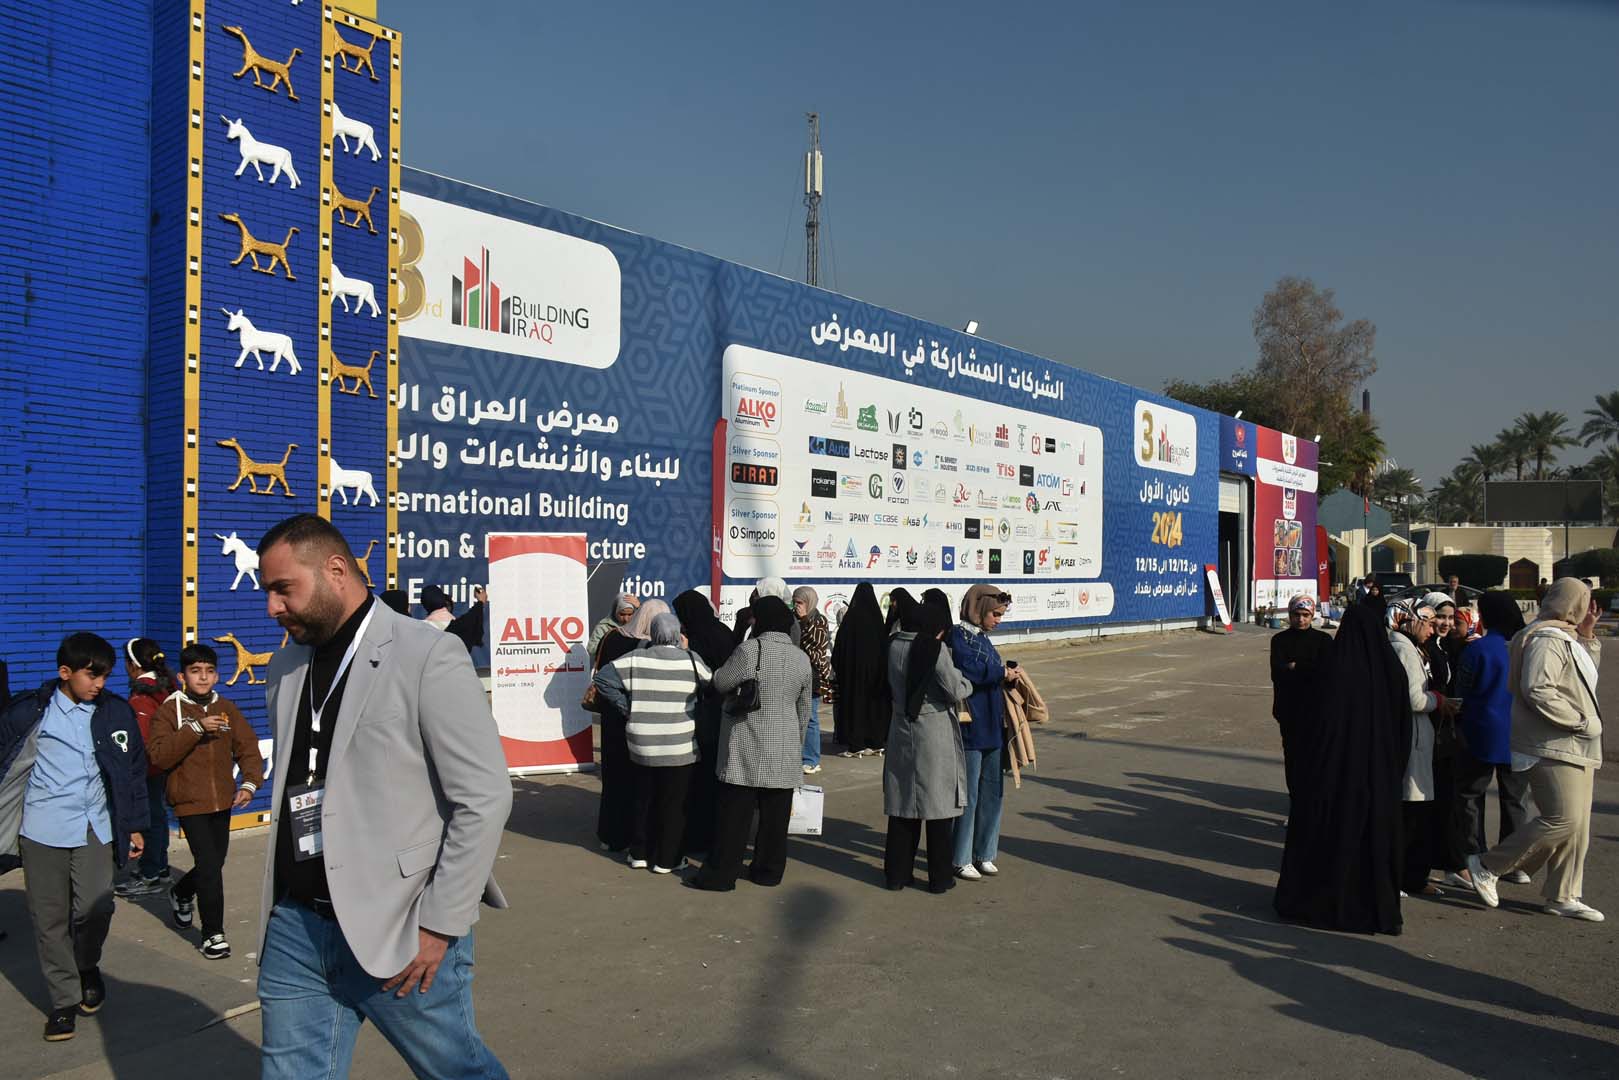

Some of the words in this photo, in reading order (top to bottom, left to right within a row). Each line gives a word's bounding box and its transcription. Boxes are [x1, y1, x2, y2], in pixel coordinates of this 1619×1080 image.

[512, 295, 590, 330] BUILDING
[512, 318, 553, 345] IRAQ
[811, 314, 896, 357] المعرض
[902, 340, 926, 376] في
[931, 340, 1004, 385] المشاركة
[732, 382, 757, 393] Platinum
[758, 387, 779, 397] Sponsor
[1007, 367, 1064, 400] الشركات
[398, 383, 420, 412] ال
[432, 386, 529, 426] العراق
[536, 401, 620, 436] معرض
[735, 417, 760, 426] Aluminum
[737, 398, 776, 428] ALKO
[1141, 410, 1154, 462] 3
[460, 437, 612, 481] والأنشاءات
[732, 445, 751, 456] Silver
[753, 448, 778, 459] Sponsor
[855, 445, 889, 461] Lactose
[620, 452, 681, 487] للبناء
[733, 465, 776, 484] FIRAT
[1036, 473, 1060, 488] ATOM
[1140, 478, 1164, 503] الأول
[1166, 484, 1190, 507] كانون
[397, 488, 530, 517] ernational
[539, 492, 629, 526] Building
[731, 508, 750, 518] Silver
[752, 510, 777, 519] Sponsor
[740, 527, 776, 541] Simpolo
[1151, 511, 1183, 548] 2024
[459, 533, 476, 559] &
[1135, 557, 1158, 573] 12/15
[1169, 558, 1188, 574] 12/12
[1134, 582, 1152, 598] بغداد
[1153, 582, 1173, 597] معرض
[500, 616, 584, 654] ALKO
[495, 646, 551, 656] Aluminum
